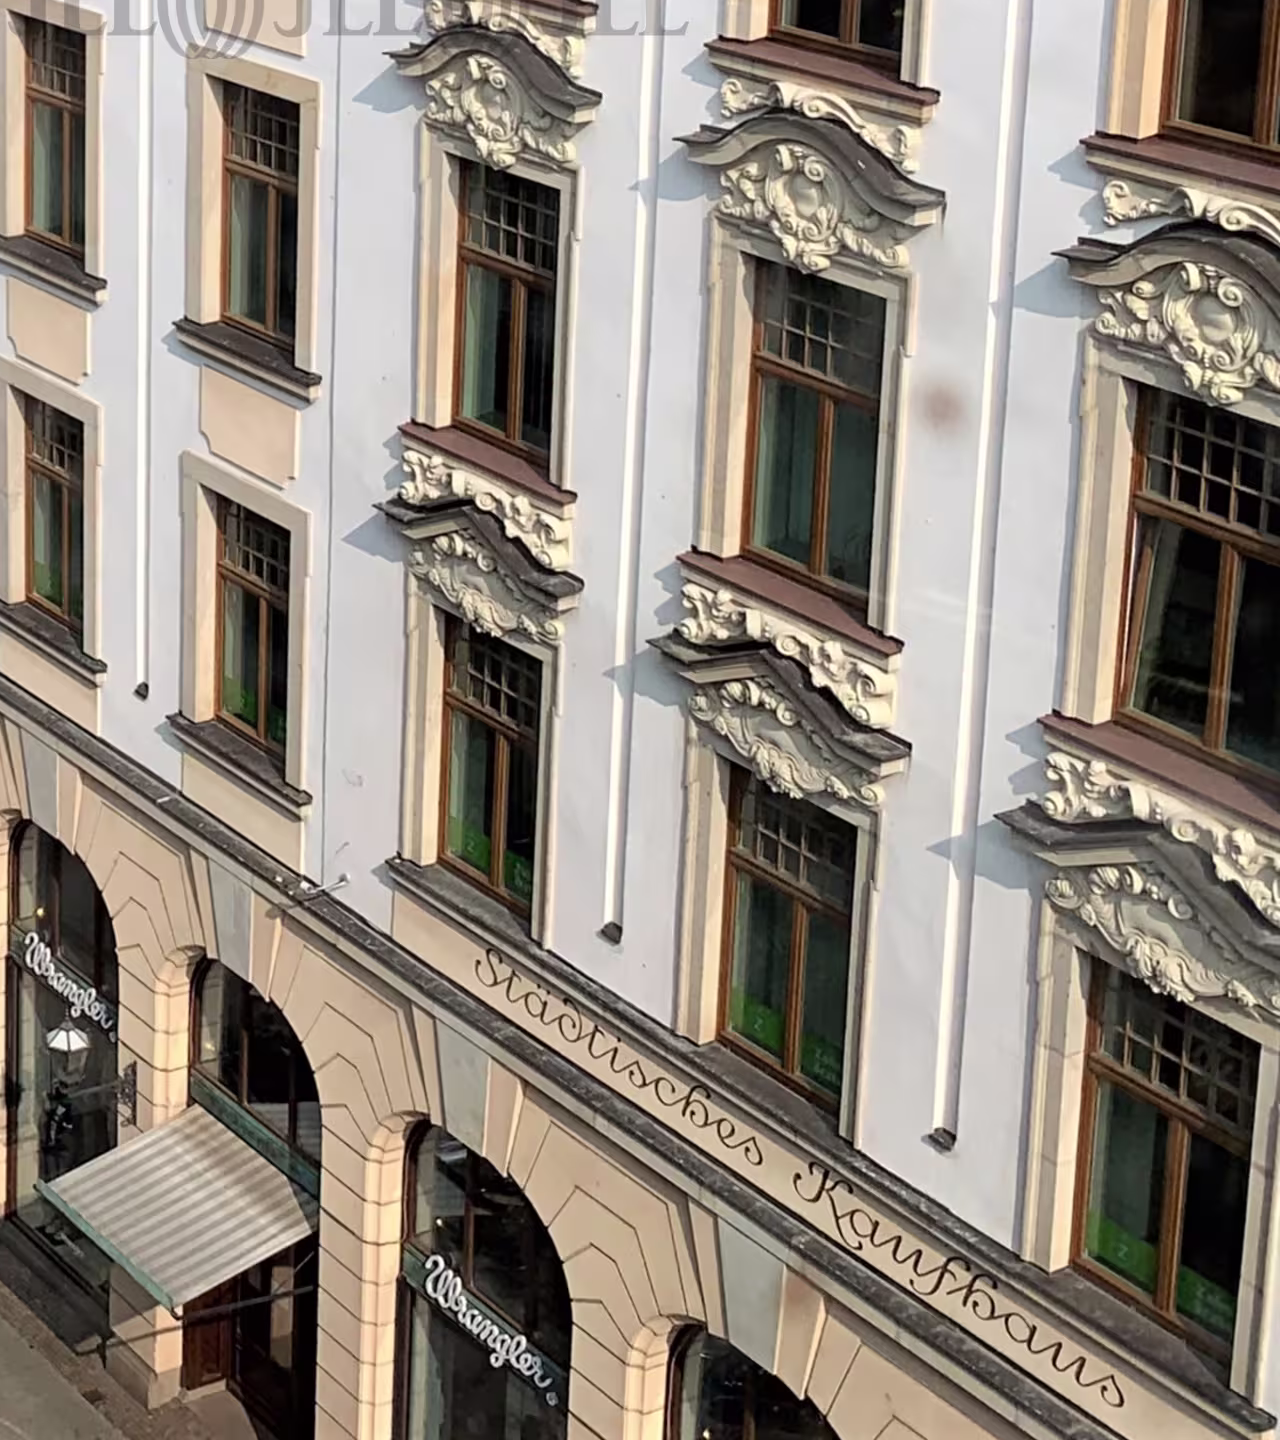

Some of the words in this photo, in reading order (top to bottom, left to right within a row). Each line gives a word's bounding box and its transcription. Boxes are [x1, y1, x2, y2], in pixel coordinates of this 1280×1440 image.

[24, 931, 114, 1029] Wrangler
[474, 947, 764, 1166] Städtisches
[792, 1160, 1126, 1408] Kaufhaus
[424, 1253, 553, 1389] Wrangler
